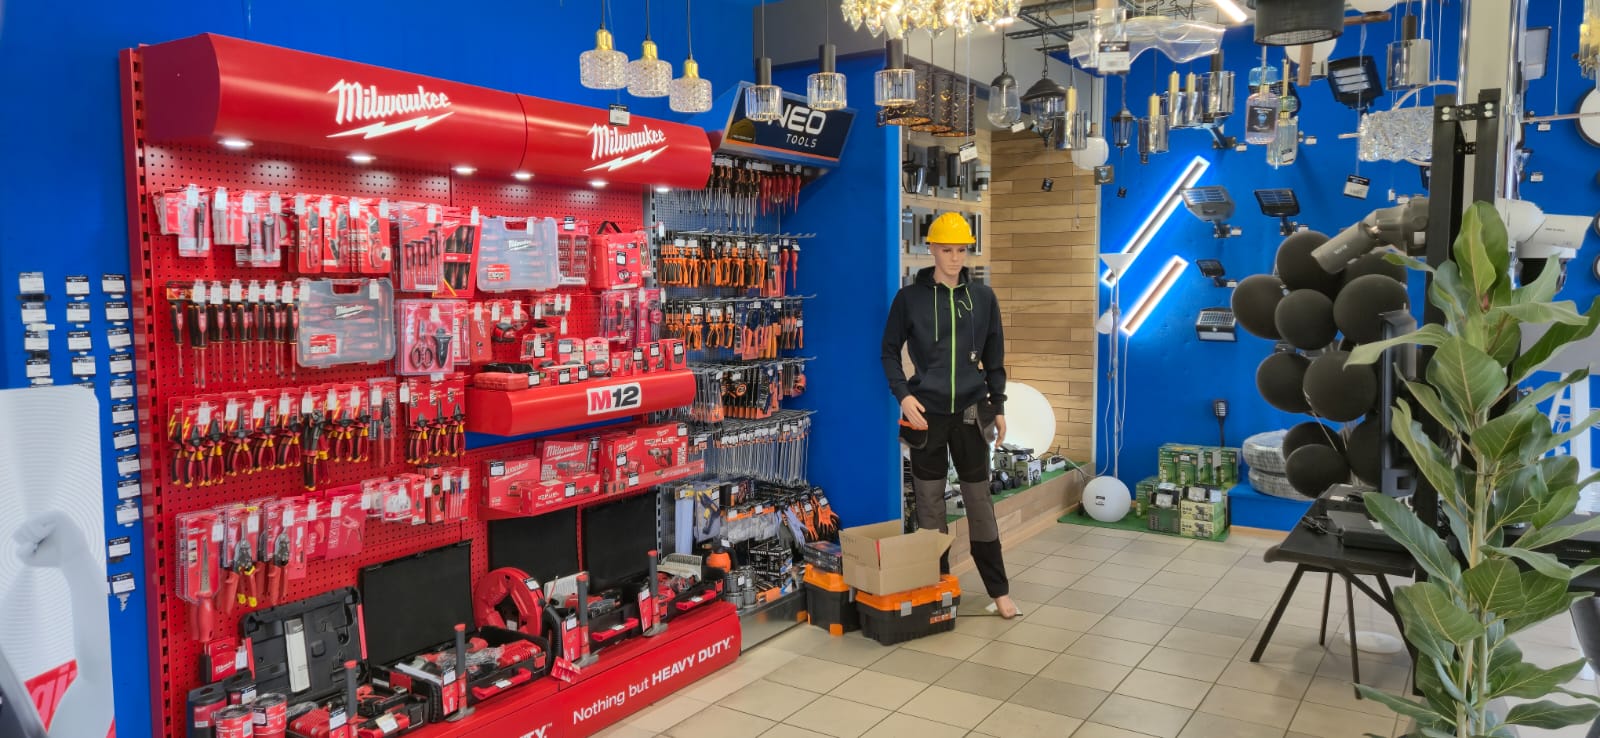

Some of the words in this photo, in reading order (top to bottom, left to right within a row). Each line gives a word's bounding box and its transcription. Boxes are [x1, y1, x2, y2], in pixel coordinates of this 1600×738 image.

[327, 78, 452, 125] Milwaukee
[586, 122, 667, 160] Milwaukee
[785, 133, 817, 148] TOOLS
[590, 385, 640, 412] M12
[573, 691, 626, 725] Nothing
[629, 678, 650, 698] but
[652, 653, 696, 686] HEAVY
